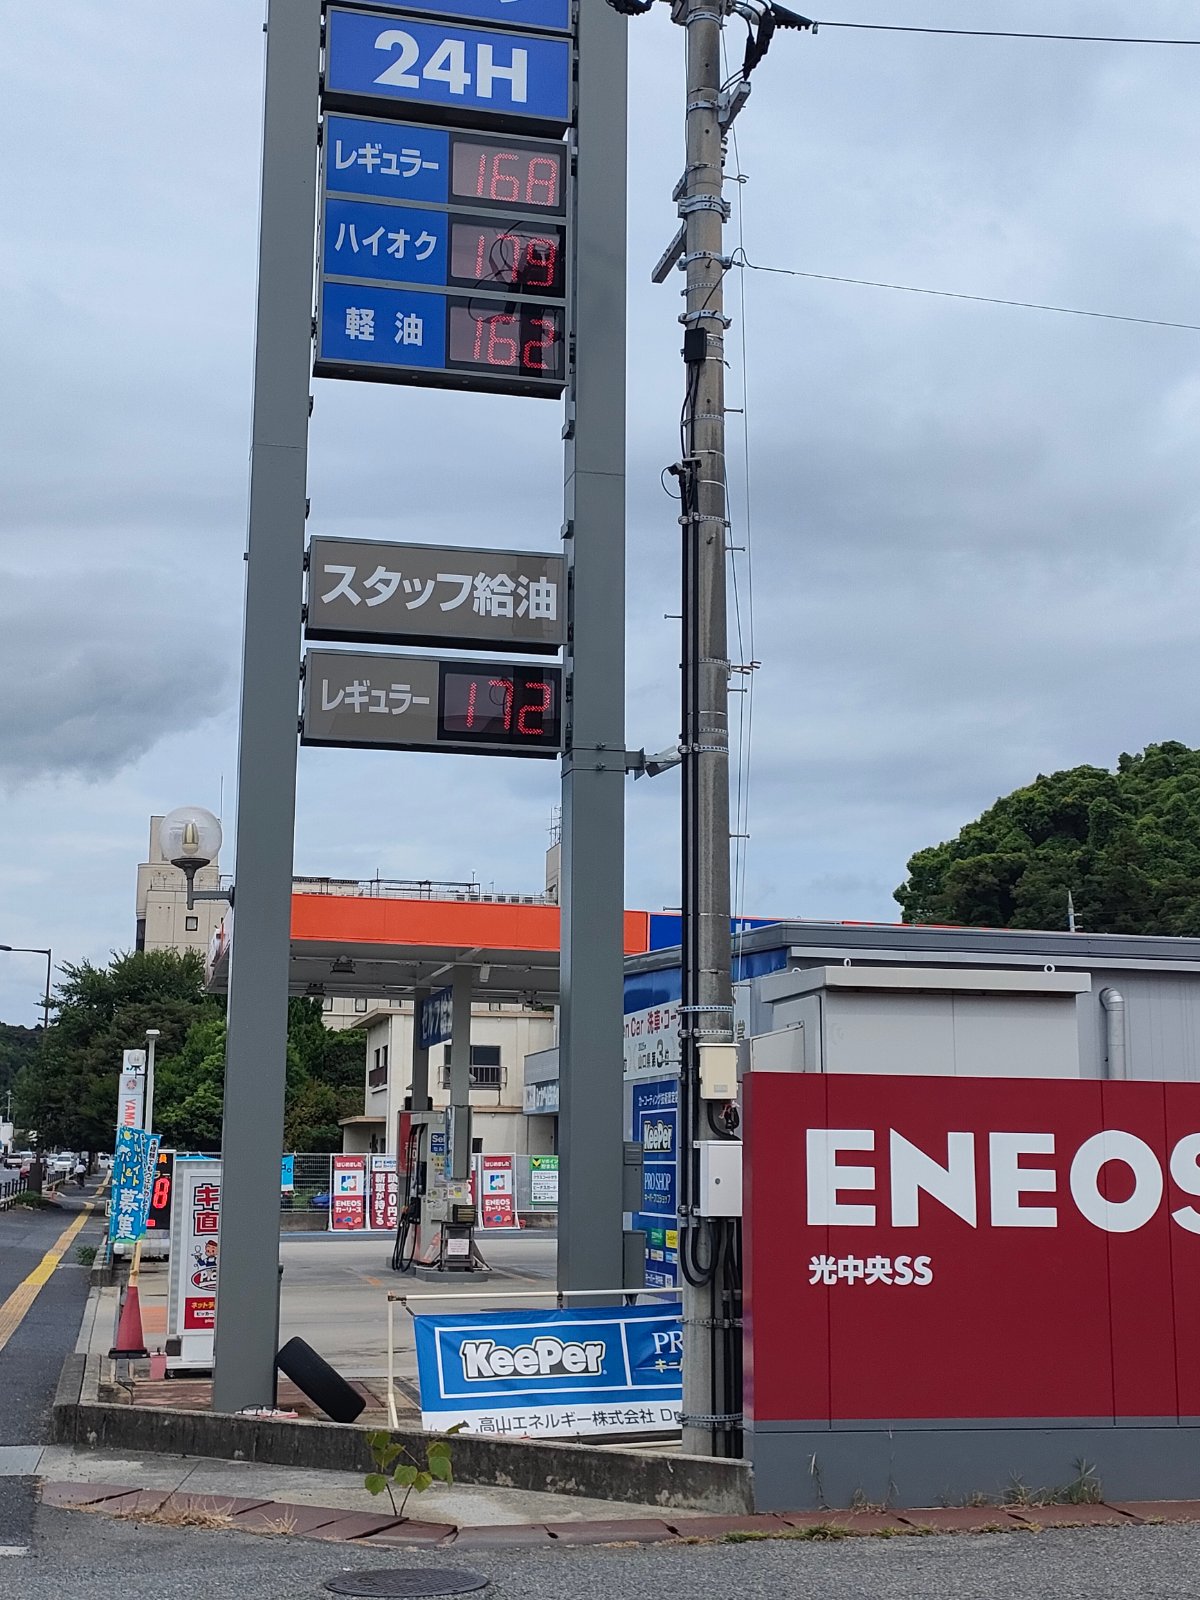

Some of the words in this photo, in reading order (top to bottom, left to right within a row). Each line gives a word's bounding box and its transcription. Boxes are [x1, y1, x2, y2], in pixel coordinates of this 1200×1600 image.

[373, 30, 528, 103] 24H
[335, 140, 439, 178] レギュラー
[476, 152, 557, 206] 168
[334, 223, 438, 261] ハイオク
[475, 234, 556, 287] 179
[473, 315, 555, 369] 162
[321, 564, 557, 621] スタッフ給油
[321, 679, 430, 715] レギュラー
[466, 679, 552, 735] 172
[631, 1017, 644, 1037] Car
[644, 1120, 673, 1152] KeePer
[375, 1173, 385, 1225] 新車が持てる
[644, 1172, 655, 1190] PRO
[656, 1173, 671, 1191] SHOP
[116, 1188, 140, 1240] 募集
[808, 1254, 934, 1286] 光中央SS
[461, 1337, 605, 1380] KeePer
[478, 1408, 656, 1434] 高山エネルギー株式会社
